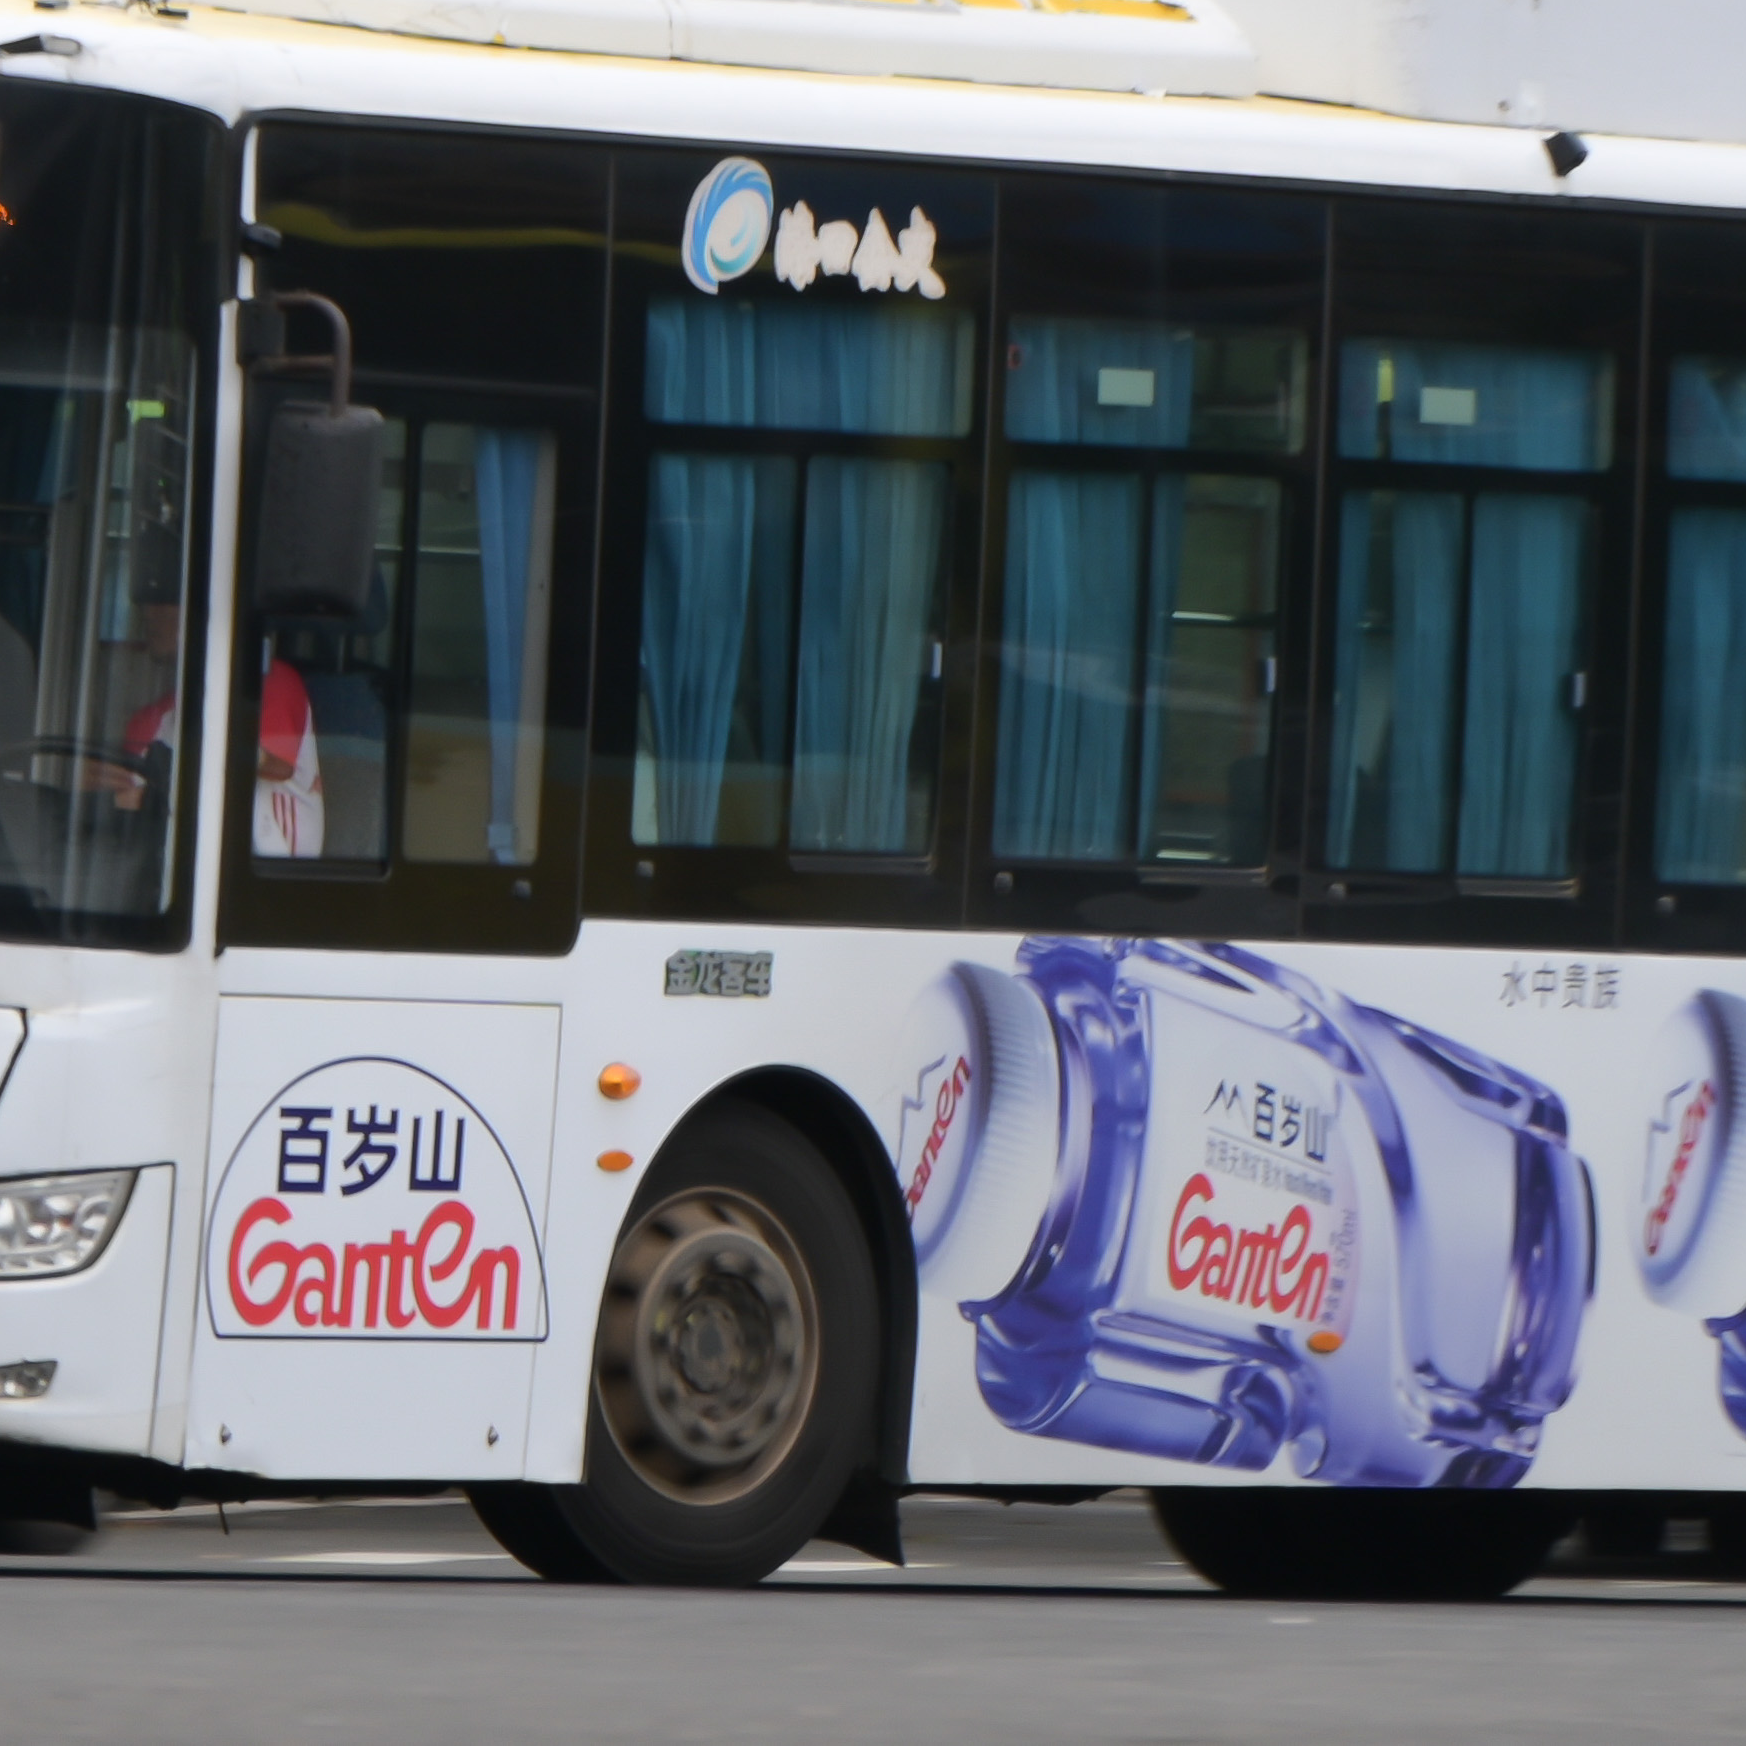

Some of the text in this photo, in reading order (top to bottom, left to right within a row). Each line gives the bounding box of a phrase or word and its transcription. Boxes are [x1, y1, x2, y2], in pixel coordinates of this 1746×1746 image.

[1498, 960, 1621, 1010] 水中贵族
[276, 1104, 466, 1197] 百岁山
[1254, 1081, 1334, 1163] 百岁山
[227, 1196, 521, 1331] Ganten
